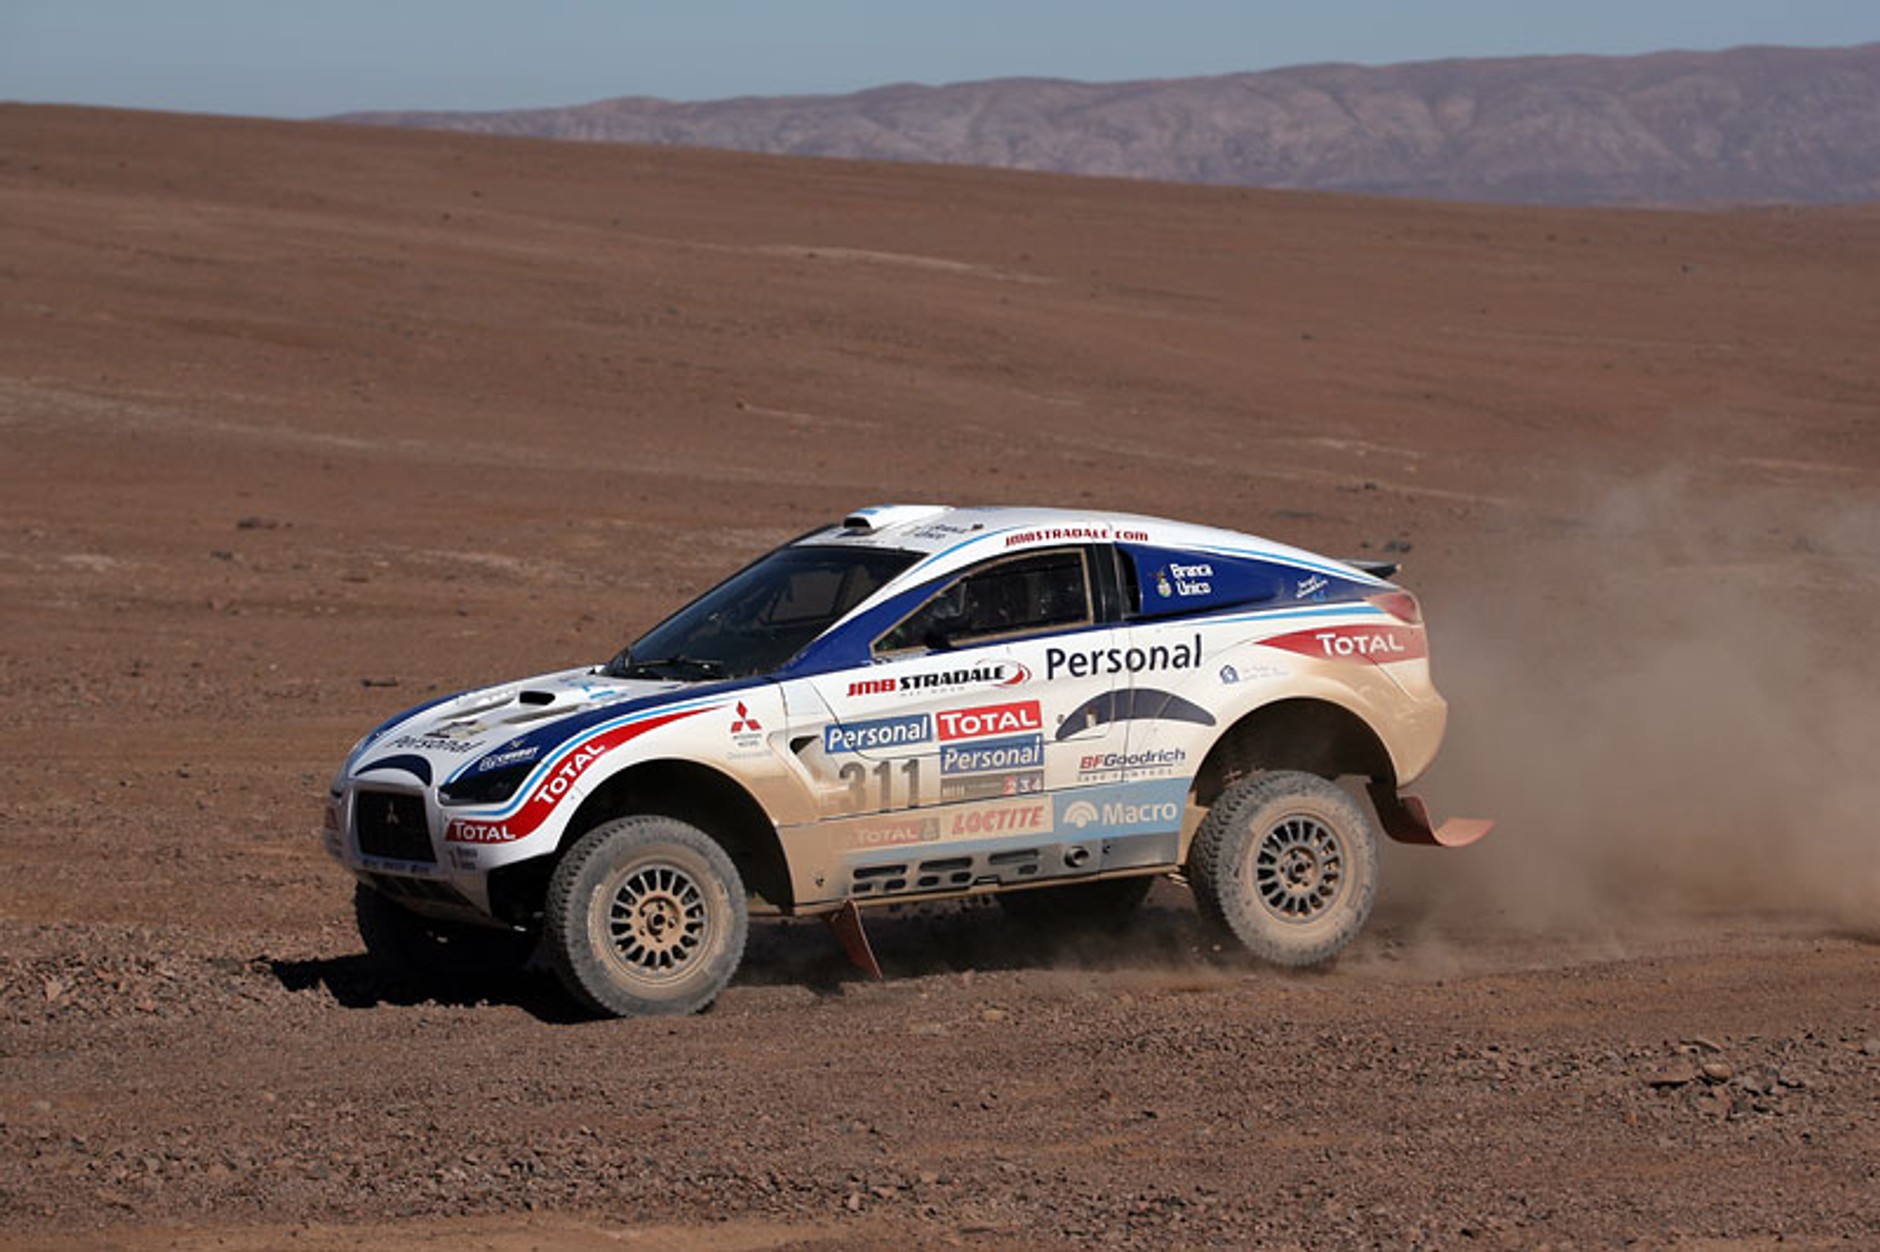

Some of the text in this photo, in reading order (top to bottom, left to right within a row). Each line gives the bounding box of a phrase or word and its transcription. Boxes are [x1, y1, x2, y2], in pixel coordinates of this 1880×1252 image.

[1046, 633, 1202, 680] Personal
[1318, 633, 1404, 655] TOTAL
[847, 678, 896, 697] JMB
[899, 665, 1004, 691] STRADALE
[829, 713, 928, 750] Personal
[940, 709, 1038, 735] TOTAL
[944, 736, 1040, 771] Personal
[1079, 748, 1186, 769] BFGoodrich
[534, 744, 605, 804] TOTAL
[839, 759, 920, 812] 311
[952, 806, 1044, 835] LOCTITE
[1102, 802, 1178, 825] Macro
[453, 821, 516, 841] TOTAL
[856, 826, 919, 844] TOTAL
